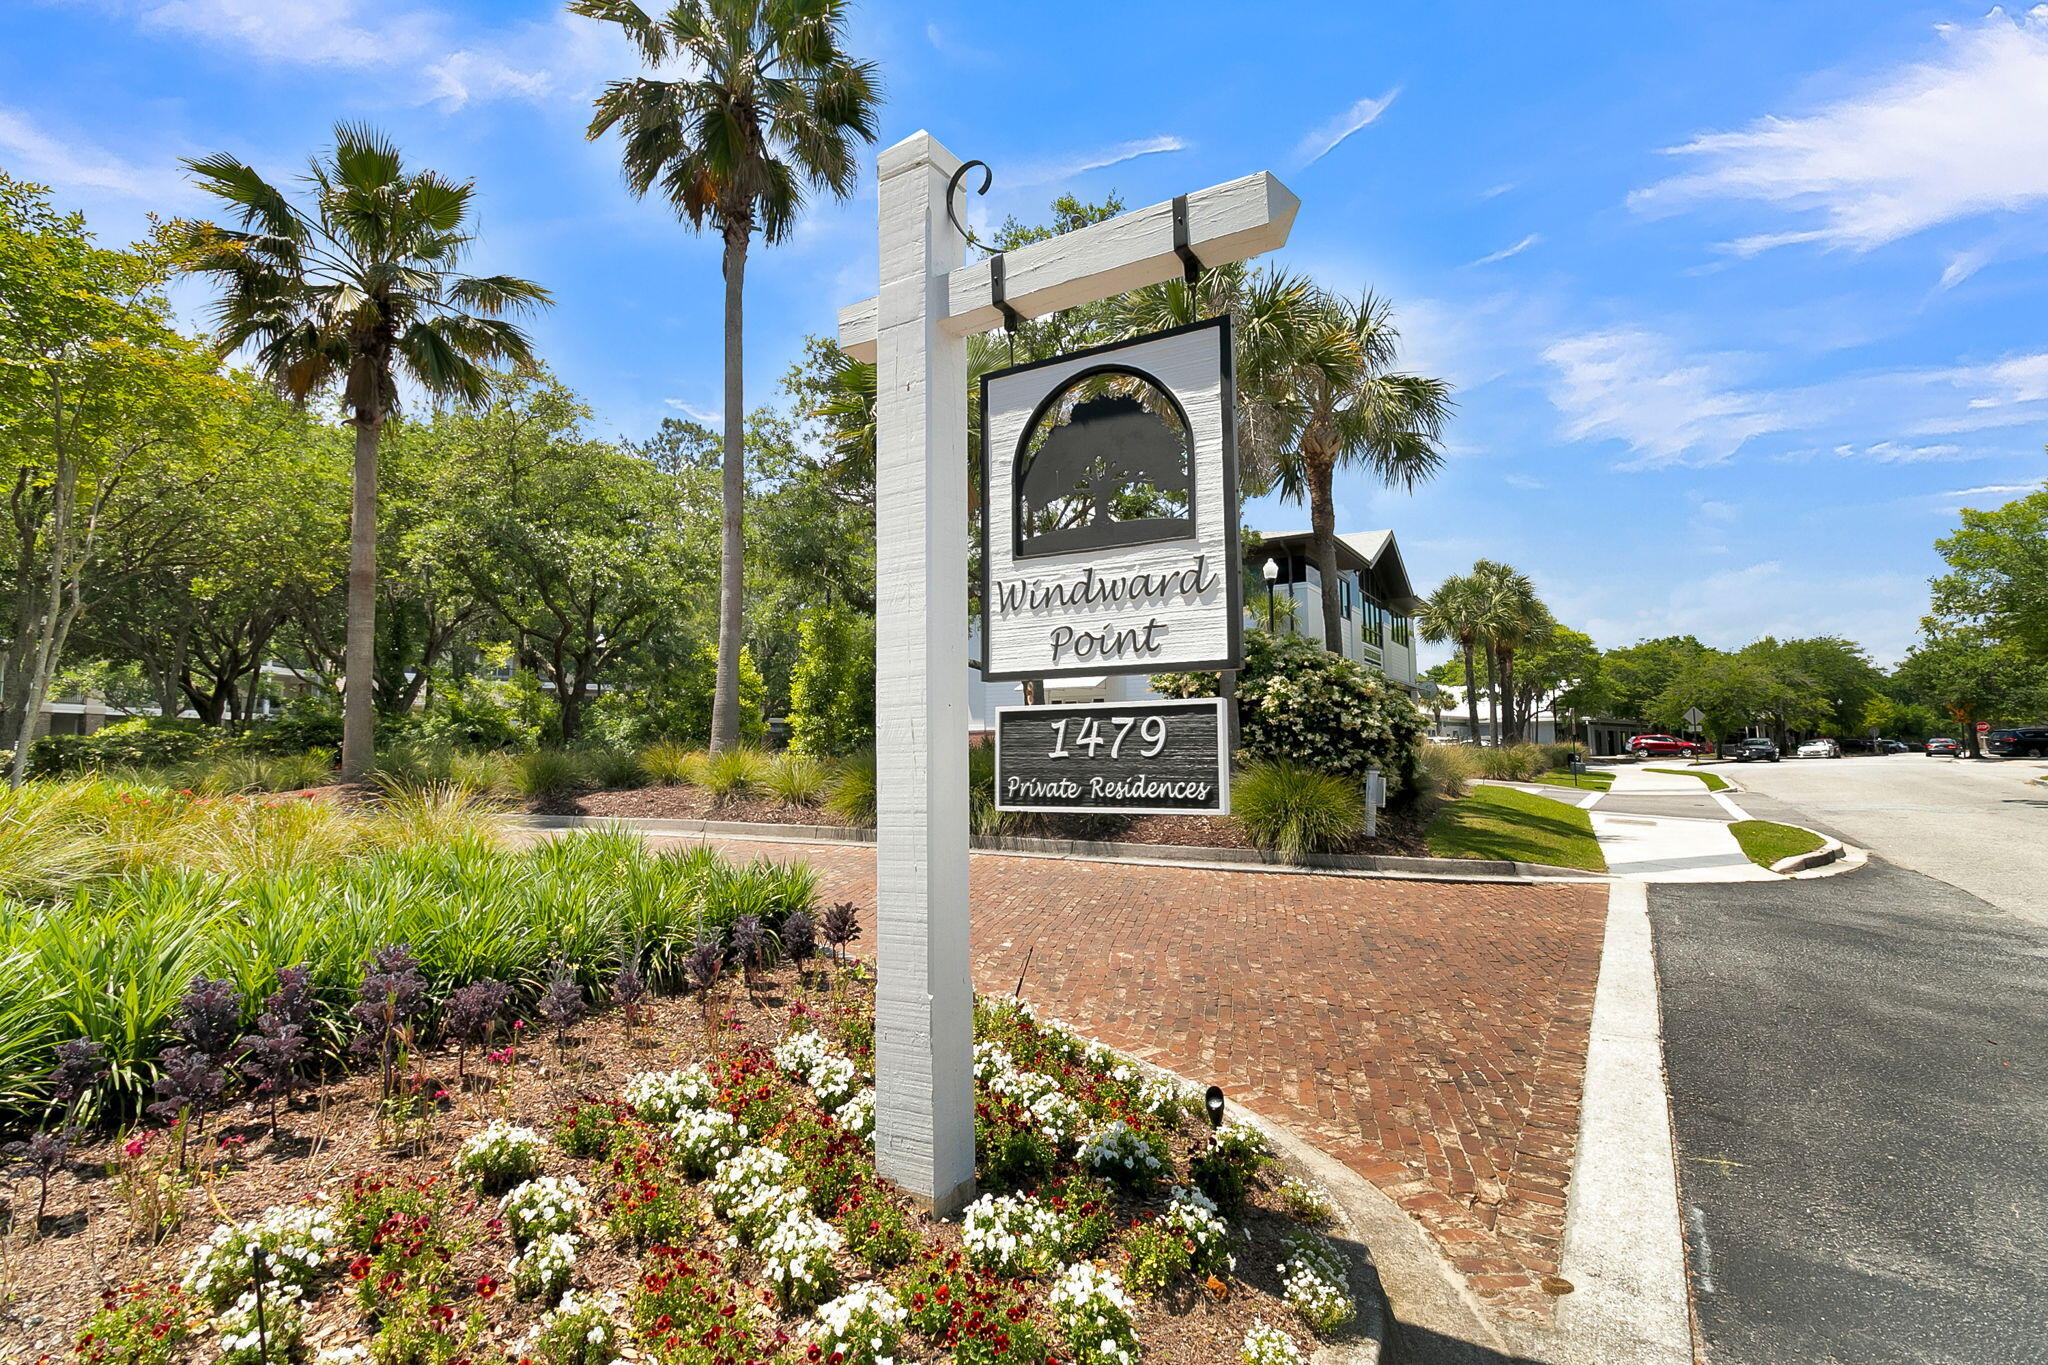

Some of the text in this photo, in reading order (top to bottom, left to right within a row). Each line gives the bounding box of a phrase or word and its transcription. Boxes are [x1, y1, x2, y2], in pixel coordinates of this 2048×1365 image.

[997, 554, 1218, 613] Windward
[1050, 618, 1168, 661] Point
[1047, 715, 1168, 759] 1479
[1007, 774, 1211, 800] Private Residences
